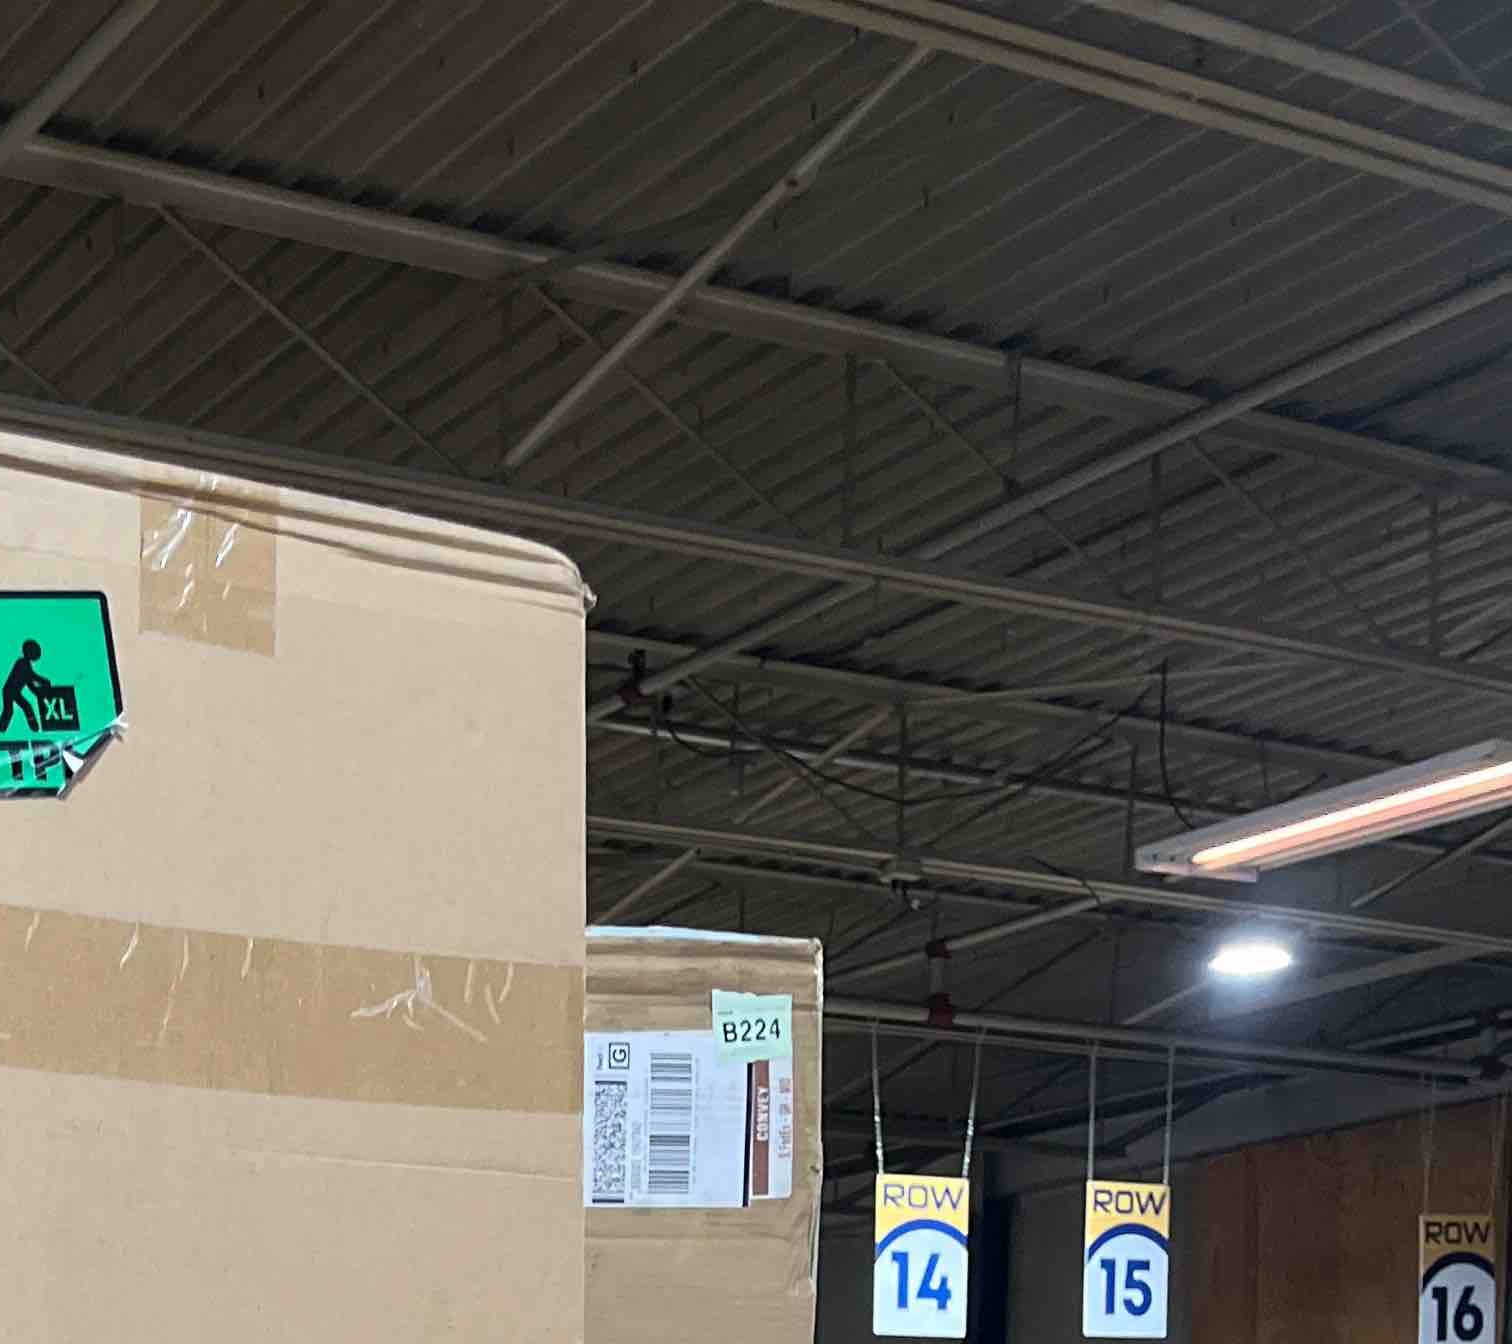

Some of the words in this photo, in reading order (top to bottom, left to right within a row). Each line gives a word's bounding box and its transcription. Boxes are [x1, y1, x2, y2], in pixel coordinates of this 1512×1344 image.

[43, 697, 74, 721] XL
[723, 1018, 780, 1043] B224
[882, 1183, 965, 1213] ROW
[1092, 1189, 1168, 1217] ROW
[1424, 1221, 1493, 1246] ROW
[891, 1251, 953, 1311] 14
[1099, 1258, 1153, 1317] 15
[1431, 1285, 1485, 1343] 16
